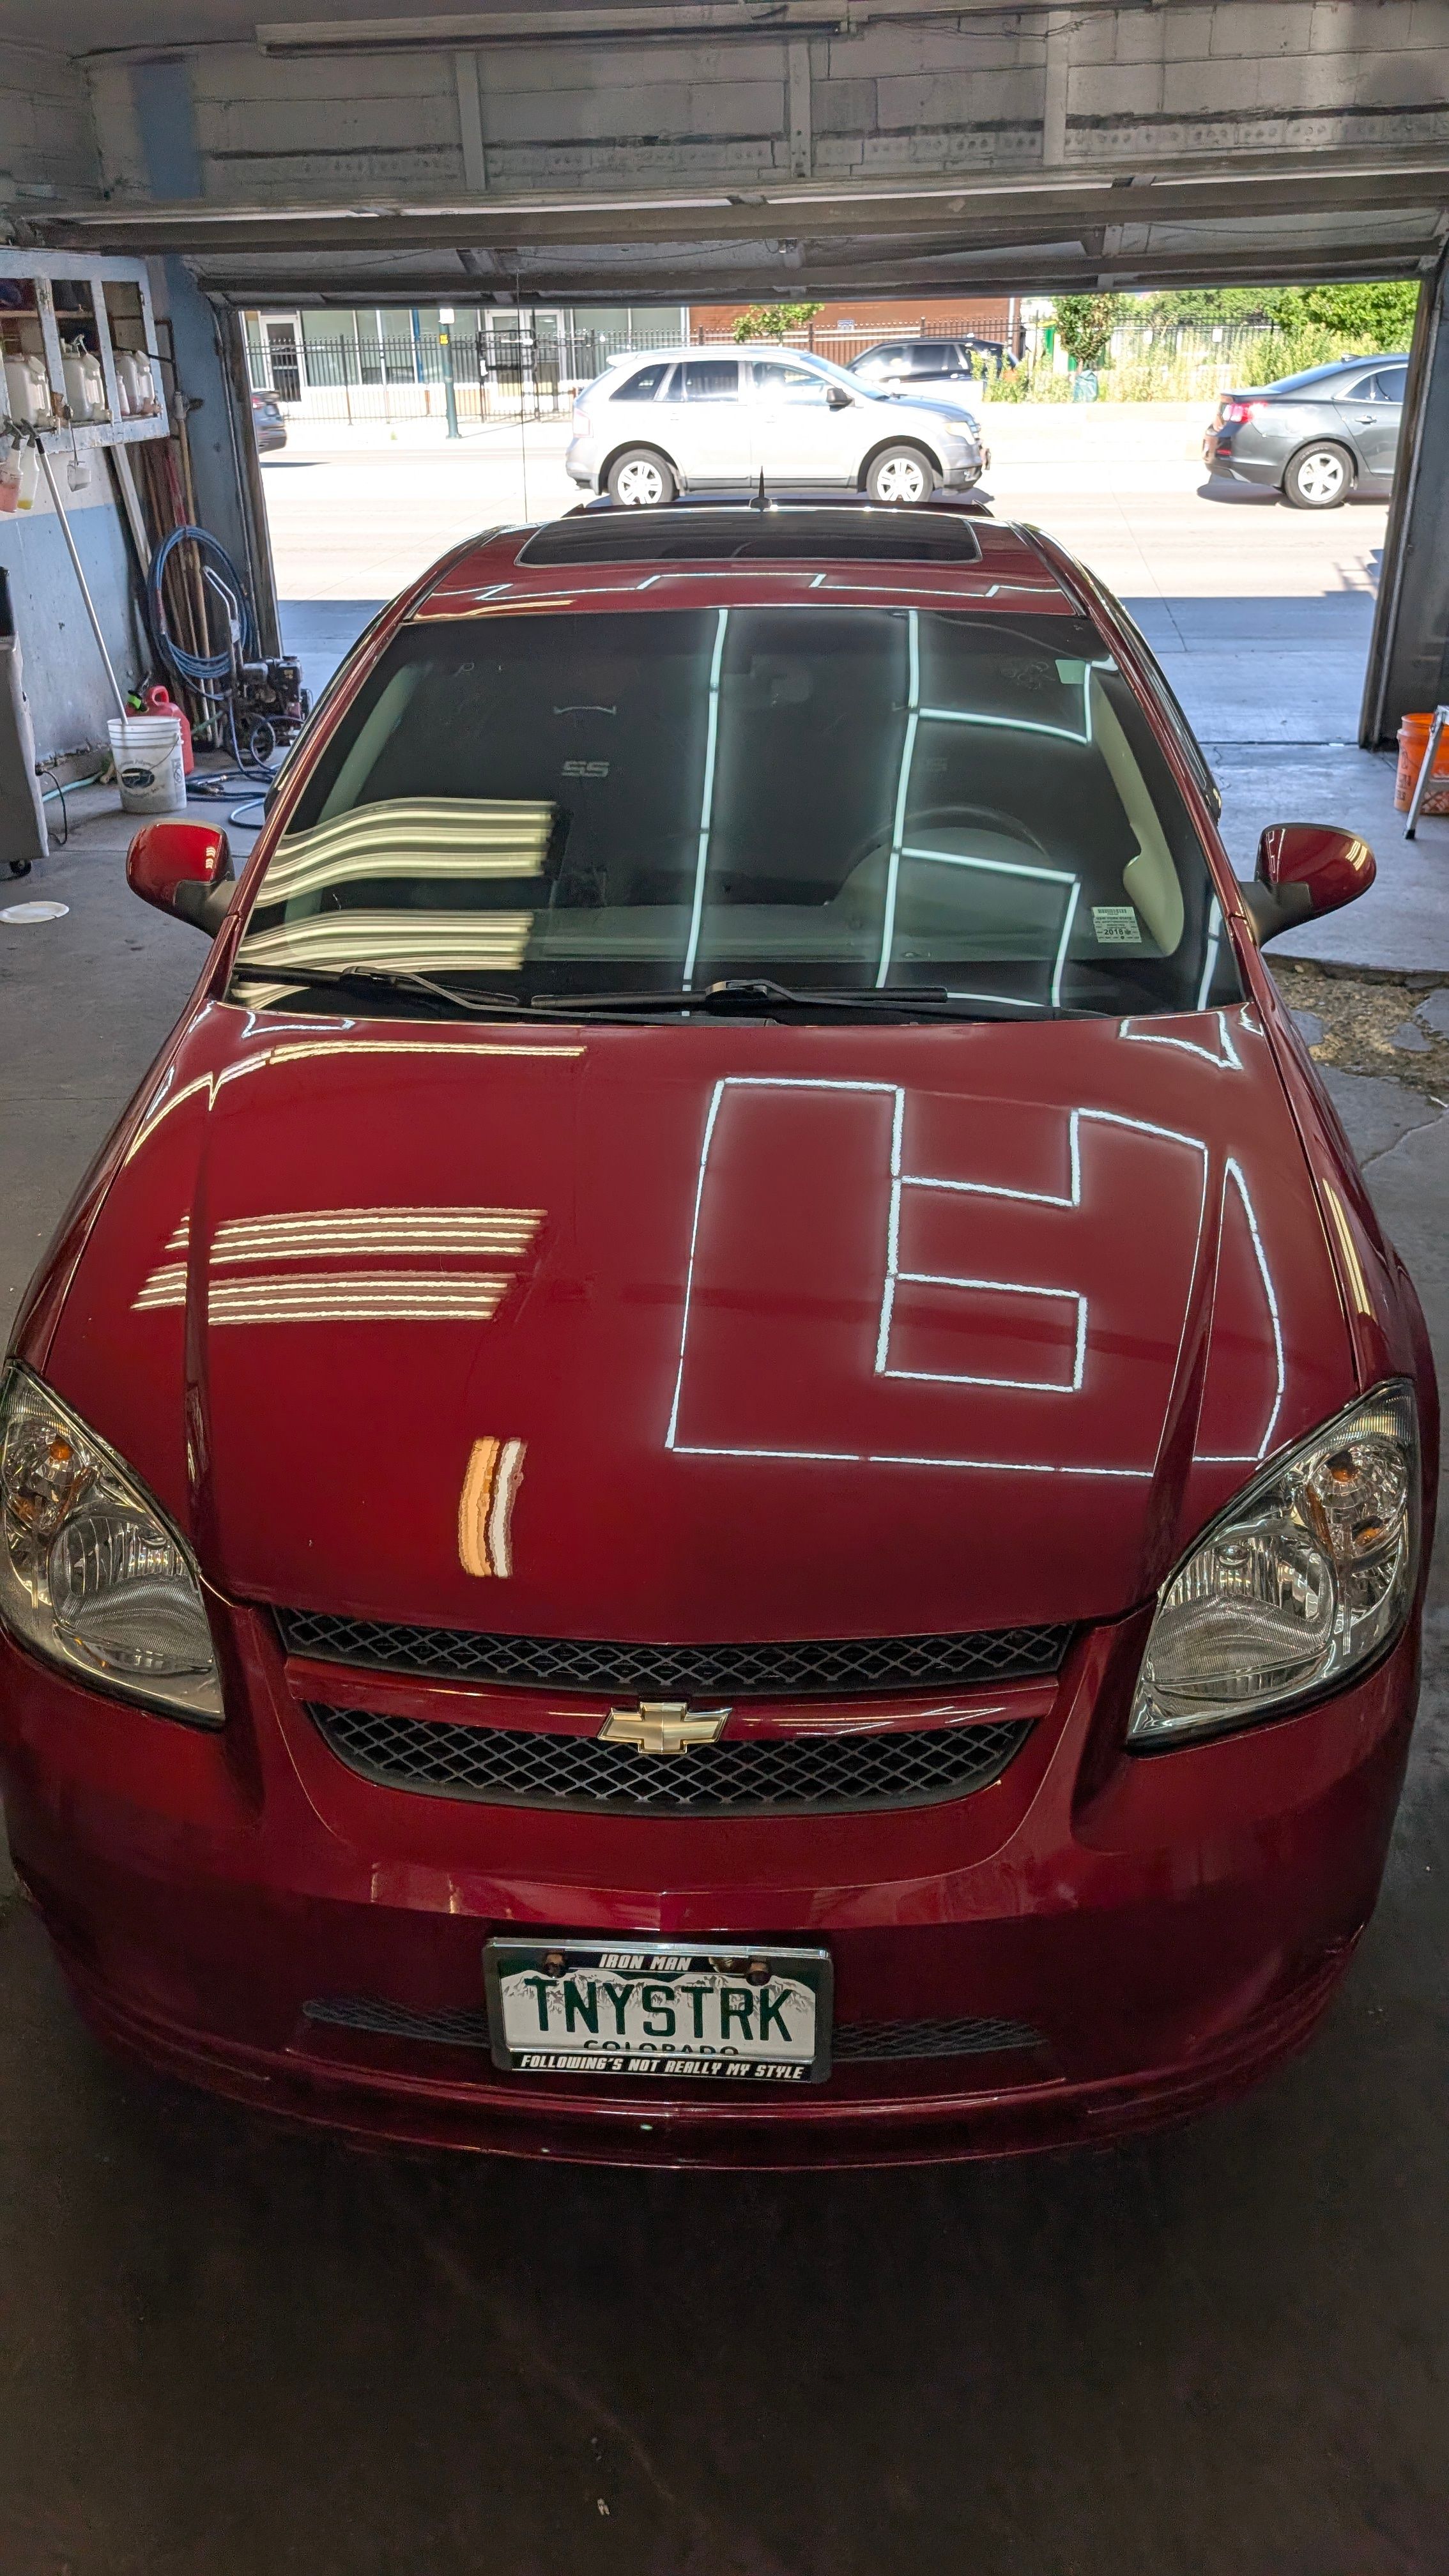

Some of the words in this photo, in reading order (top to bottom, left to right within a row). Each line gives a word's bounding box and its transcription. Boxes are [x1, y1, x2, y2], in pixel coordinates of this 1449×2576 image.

[562, 761, 610, 777] SS
[599, 1954, 645, 1969] IRON
[649, 1956, 693, 1971] MAN
[524, 1977, 793, 2042] TNYSTRK
[521, 2055, 624, 2071] FOLLOWING'S
[627, 2058, 661, 2073] NOT
[664, 2060, 723, 2075] REALLY
[725, 2063, 751, 2076] MY
[754, 2064, 805, 2080] STYLE
